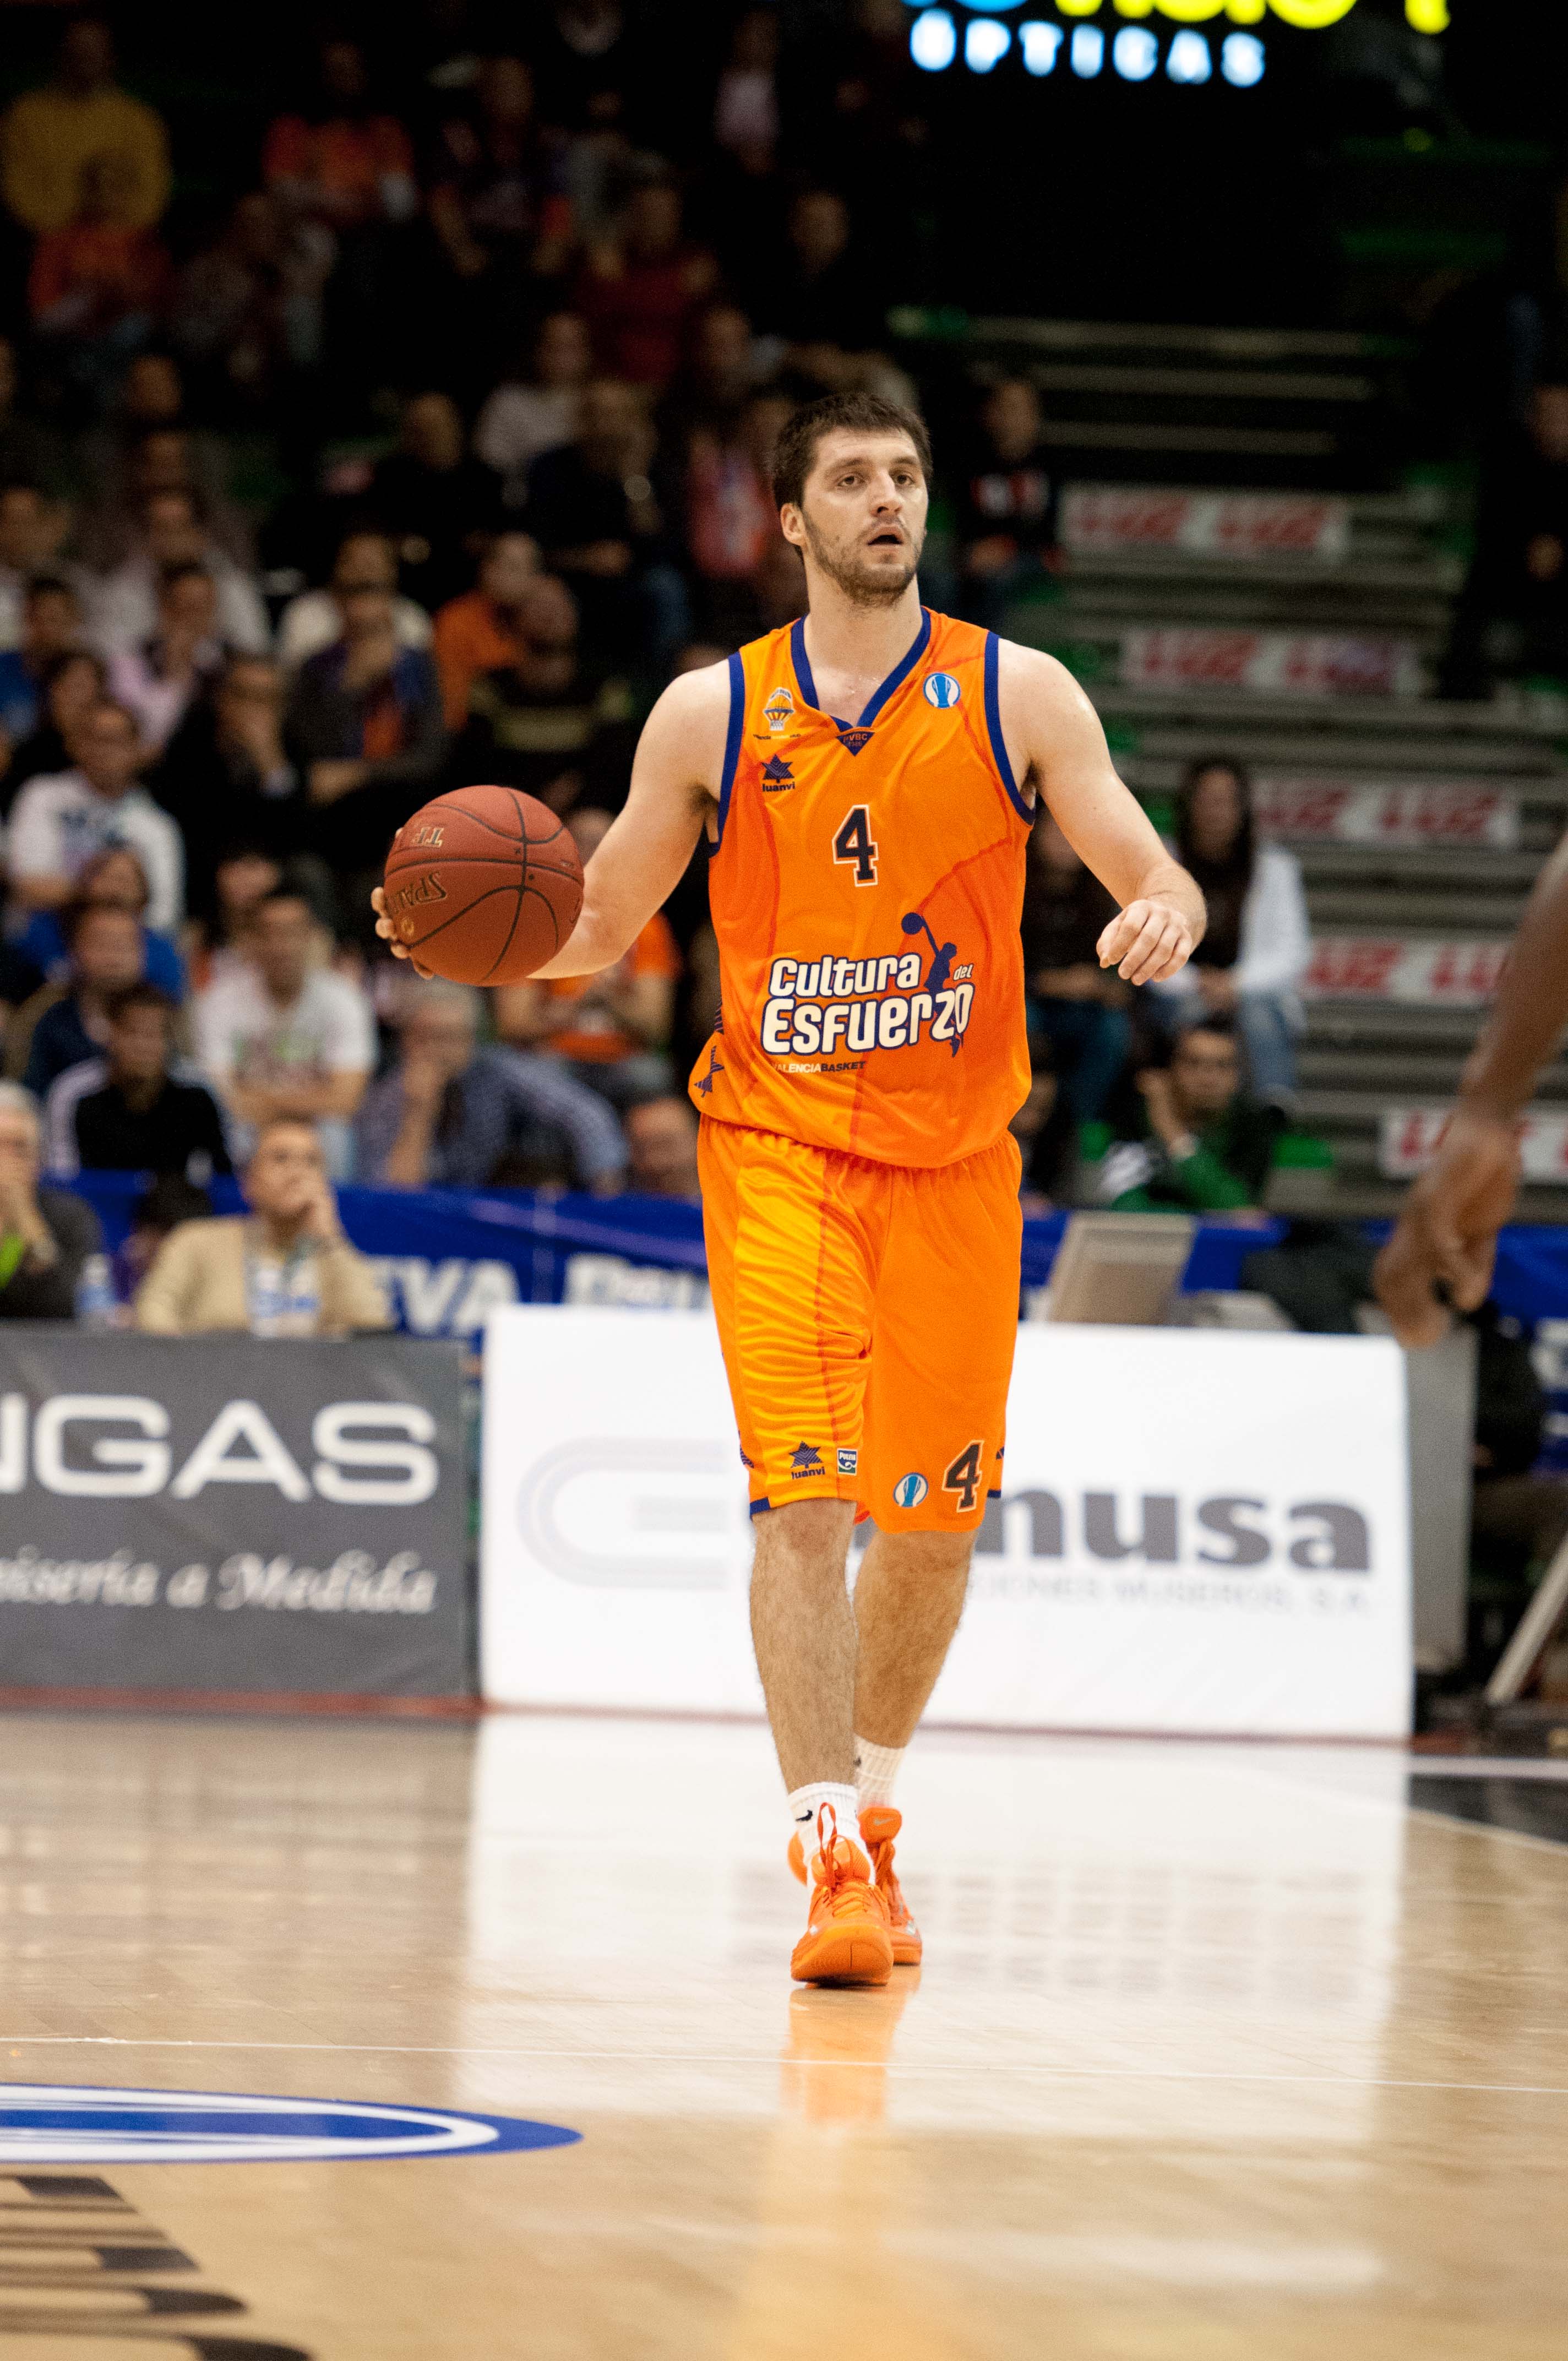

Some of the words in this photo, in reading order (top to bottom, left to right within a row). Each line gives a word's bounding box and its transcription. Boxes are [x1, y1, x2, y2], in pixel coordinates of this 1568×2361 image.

[762, 781, 796, 792] luanvi
[831, 804, 879, 887] 4
[769, 953, 922, 998] Cultura
[953, 963, 974, 981] del
[791, 1466, 825, 1479] luanvi
[941, 1439, 984, 1513] 4
